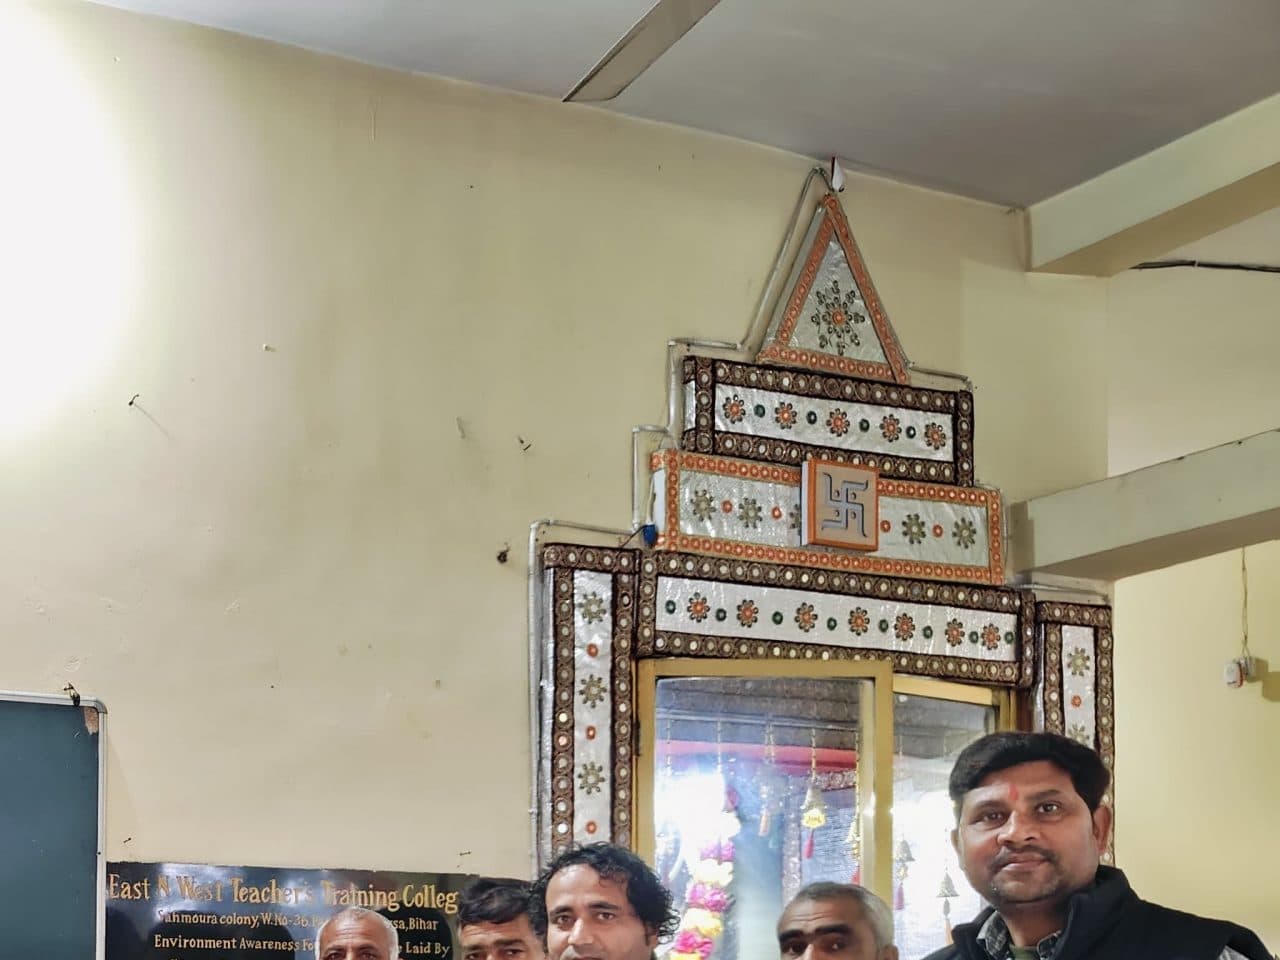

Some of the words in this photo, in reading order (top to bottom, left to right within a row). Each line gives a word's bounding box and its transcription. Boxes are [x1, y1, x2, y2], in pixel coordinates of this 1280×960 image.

[109, 873, 151, 901] East
[176, 875, 224, 902] West
[321, 880, 400, 912] Training
[403, 884, 460, 914] Colleg
[154, 935, 237, 950] Environment
[239, 937, 300, 951] Awareness
[405, 941, 431, 955] Laid
[434, 943, 451, 959] By
